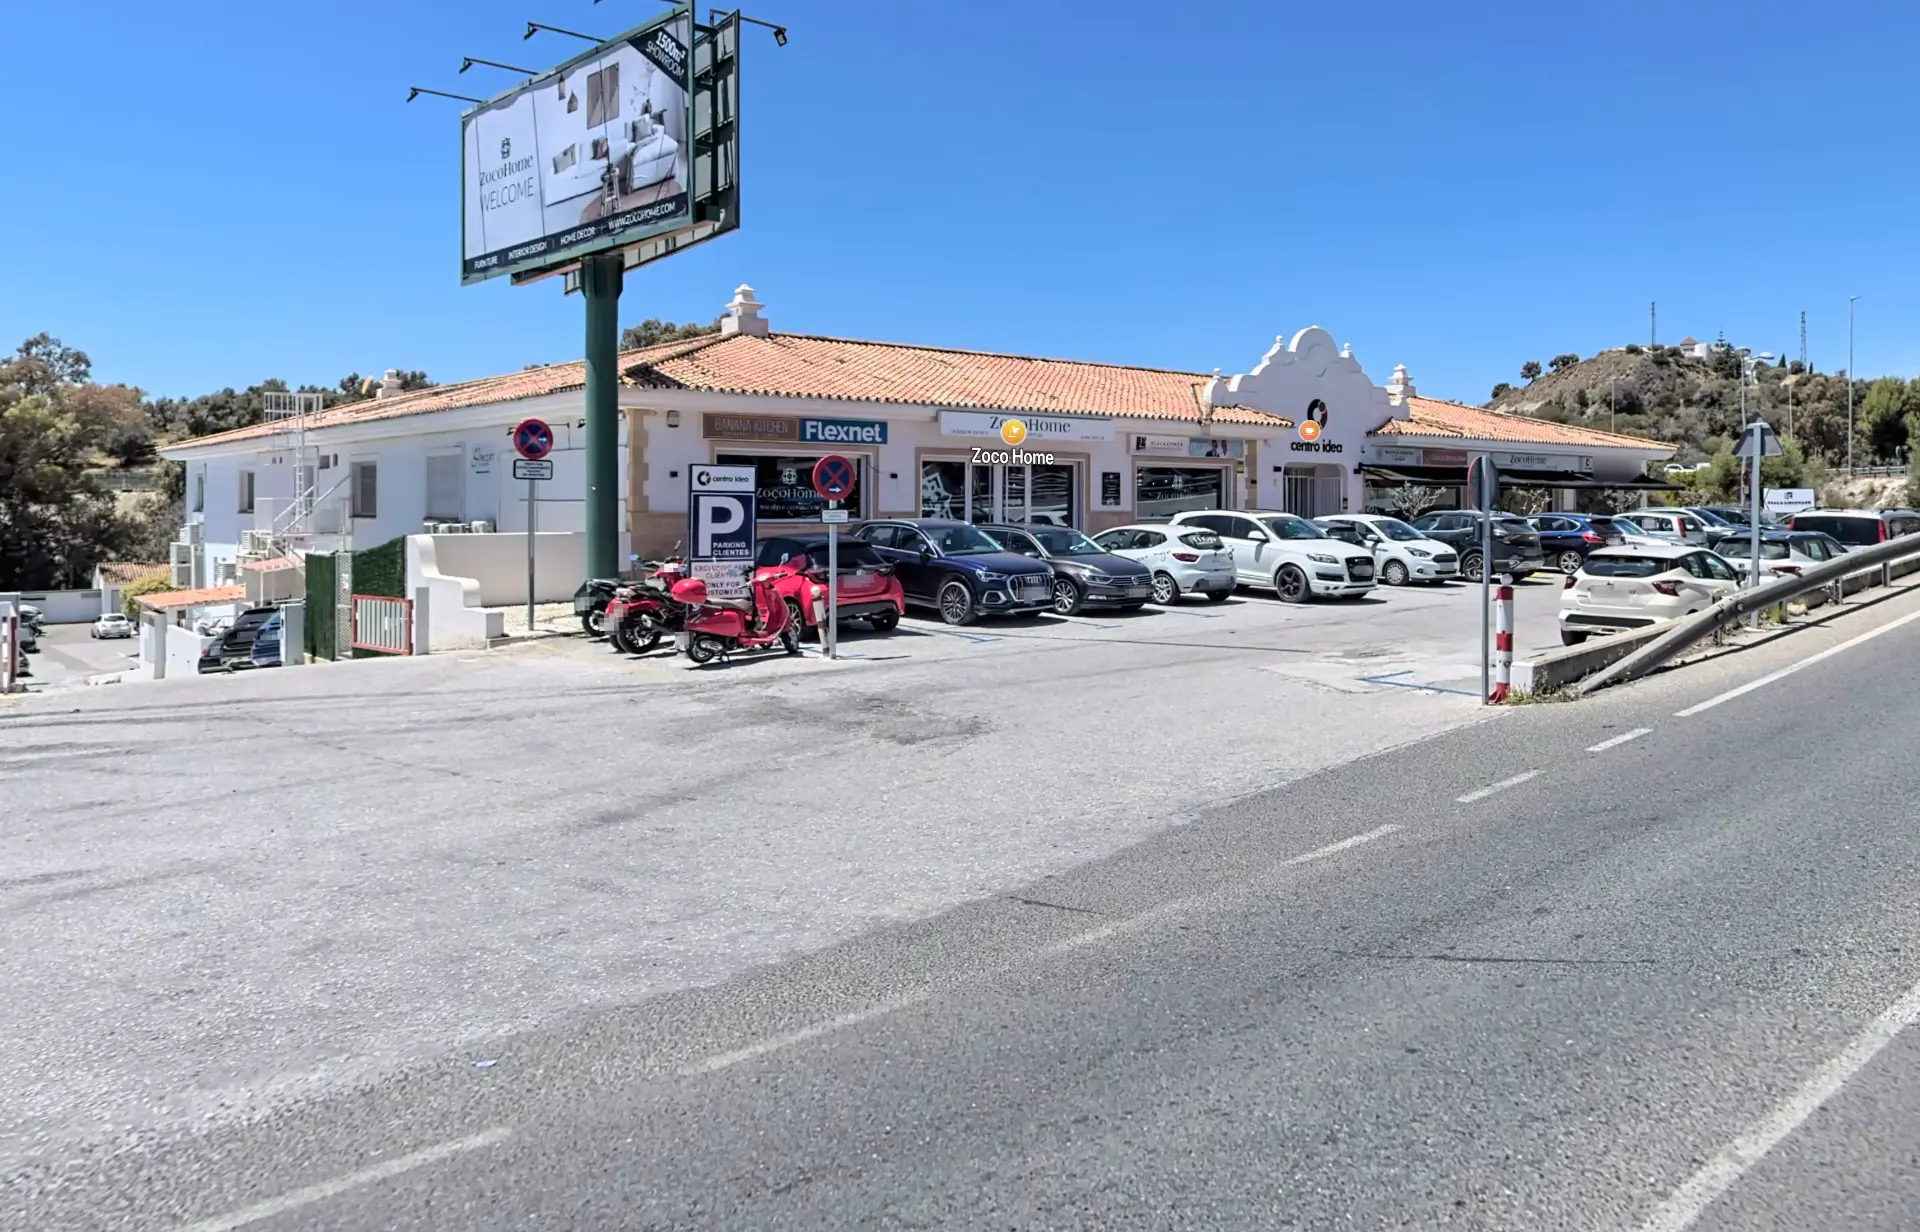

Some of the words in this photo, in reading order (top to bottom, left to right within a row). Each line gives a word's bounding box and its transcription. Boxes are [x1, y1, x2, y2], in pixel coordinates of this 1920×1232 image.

[646, 41, 684, 79] SHOWROOM
[480, 155, 533, 186] ZocoHome
[481, 177, 534, 211] WELCOME
[474, 256, 498, 269] FURNITURE
[508, 246, 528, 260] INTERIOR
[528, 242, 547, 255] DESIGN
[560, 232, 577, 245] HOME
[577, 226, 596, 242] DECOR
[714, 417, 751, 432] BANANA
[754, 420, 788, 433] KITCHEN
[805, 420, 882, 442] Flexnet
[989, 416, 1071, 433] ZoHome
[1290, 441, 1320, 452] centro
[1322, 438, 1343, 453] idea
[712, 475, 733, 483] centro
[734, 475, 749, 483] idea
[698, 496, 745, 556] P
[713, 541, 746, 549] PARKING
[707, 588, 744, 596] STOMERS
